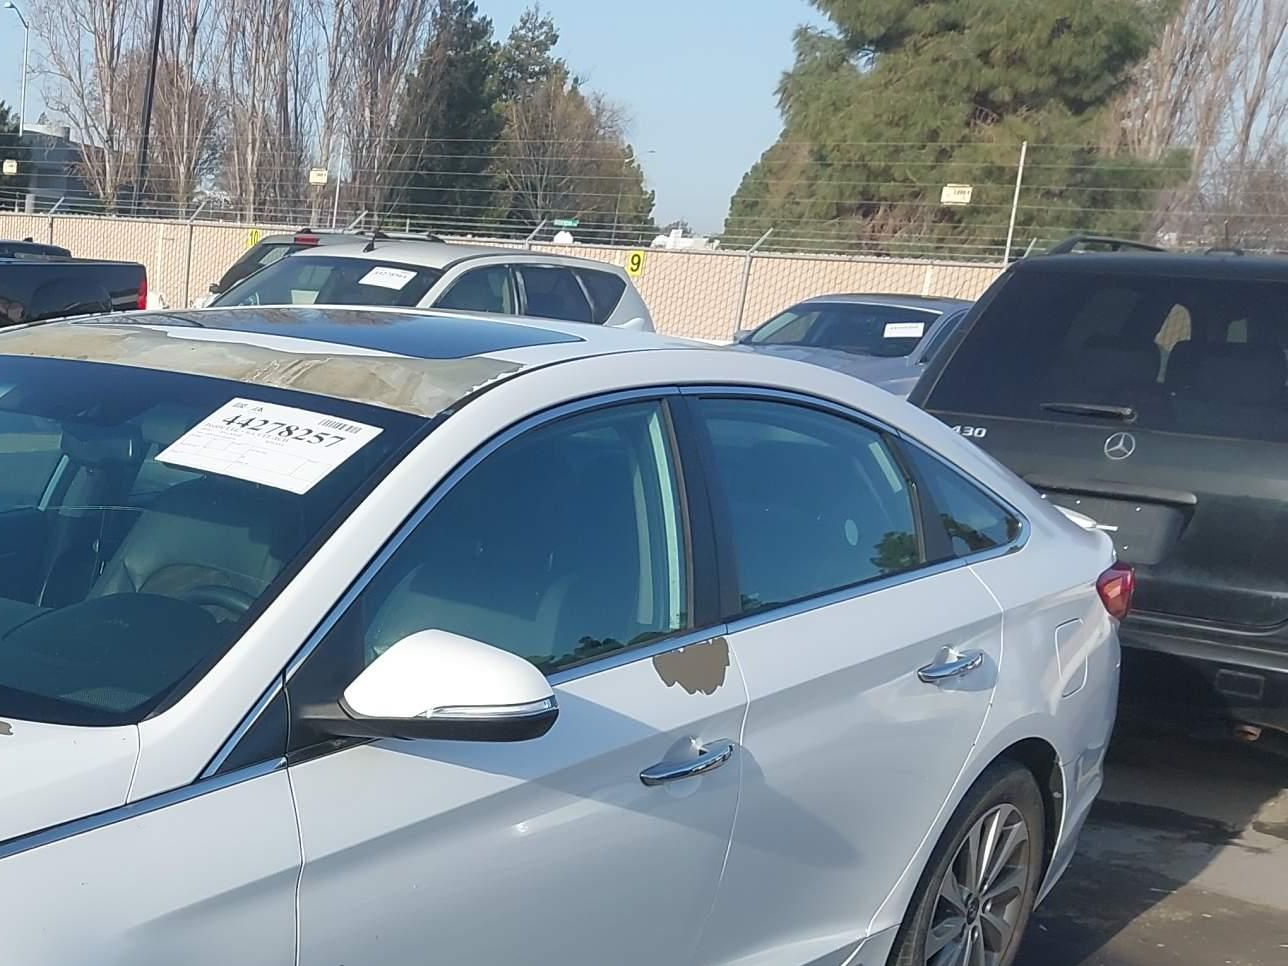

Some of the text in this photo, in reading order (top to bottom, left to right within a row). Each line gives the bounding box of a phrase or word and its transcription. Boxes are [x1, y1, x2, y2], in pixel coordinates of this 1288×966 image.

[250, 230, 259, 246] 10
[630, 253, 641, 272] 9
[222, 414, 347, 448] 44278257
